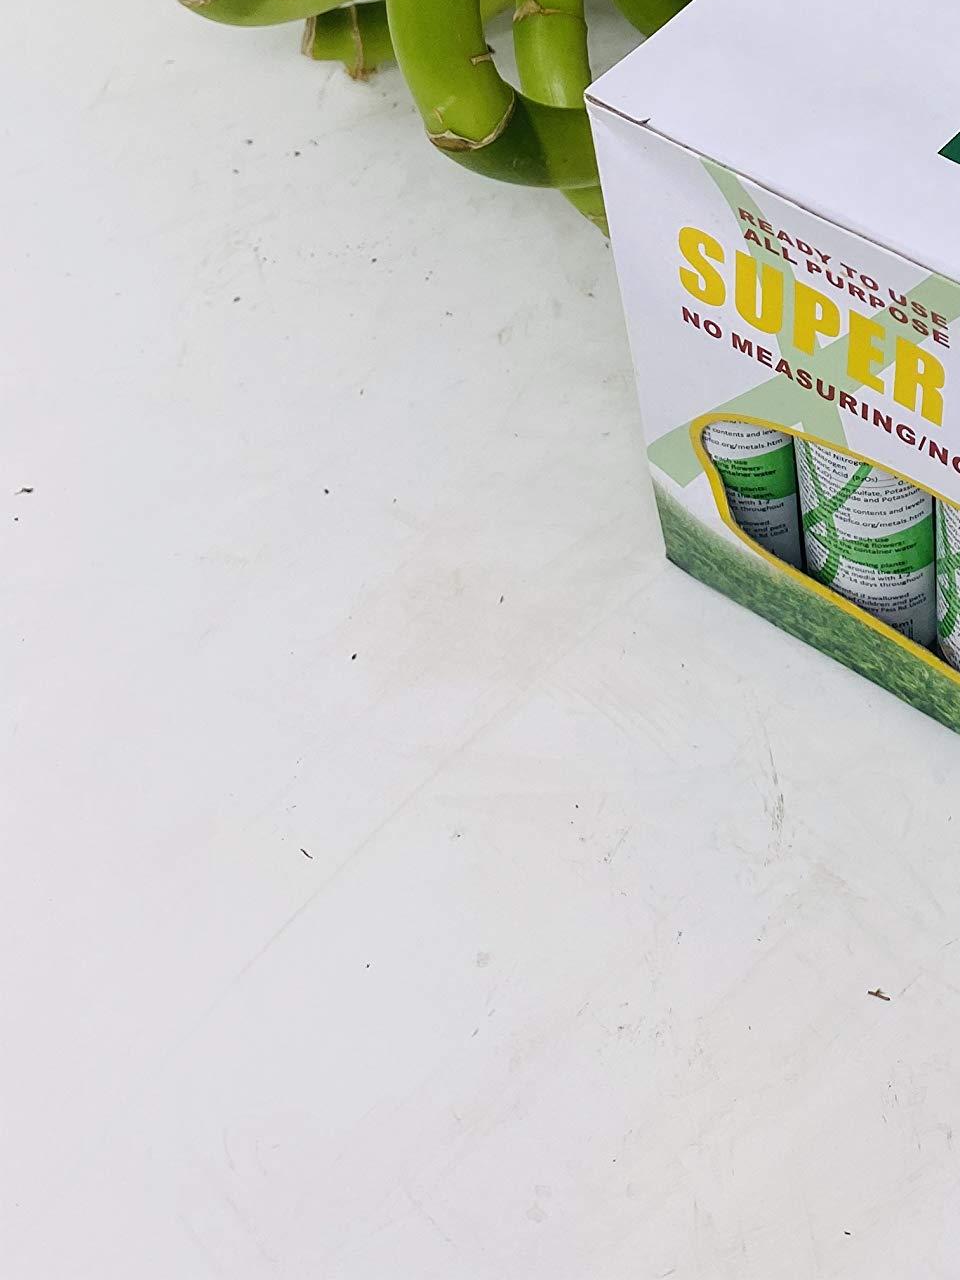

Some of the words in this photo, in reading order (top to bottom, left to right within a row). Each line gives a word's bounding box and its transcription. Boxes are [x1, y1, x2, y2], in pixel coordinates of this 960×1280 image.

[738, 207, 831, 264] READY
[840, 262, 879, 291] TO
[888, 288, 948, 329] USE
[743, 228, 798, 265] ALL
[806, 259, 950, 348] PURPOSE
[678, 226, 945, 427] SUPER
[681, 306, 722, 339] NO
[712, 427, 744, 438] contents
[853, 508, 887, 516] contents
